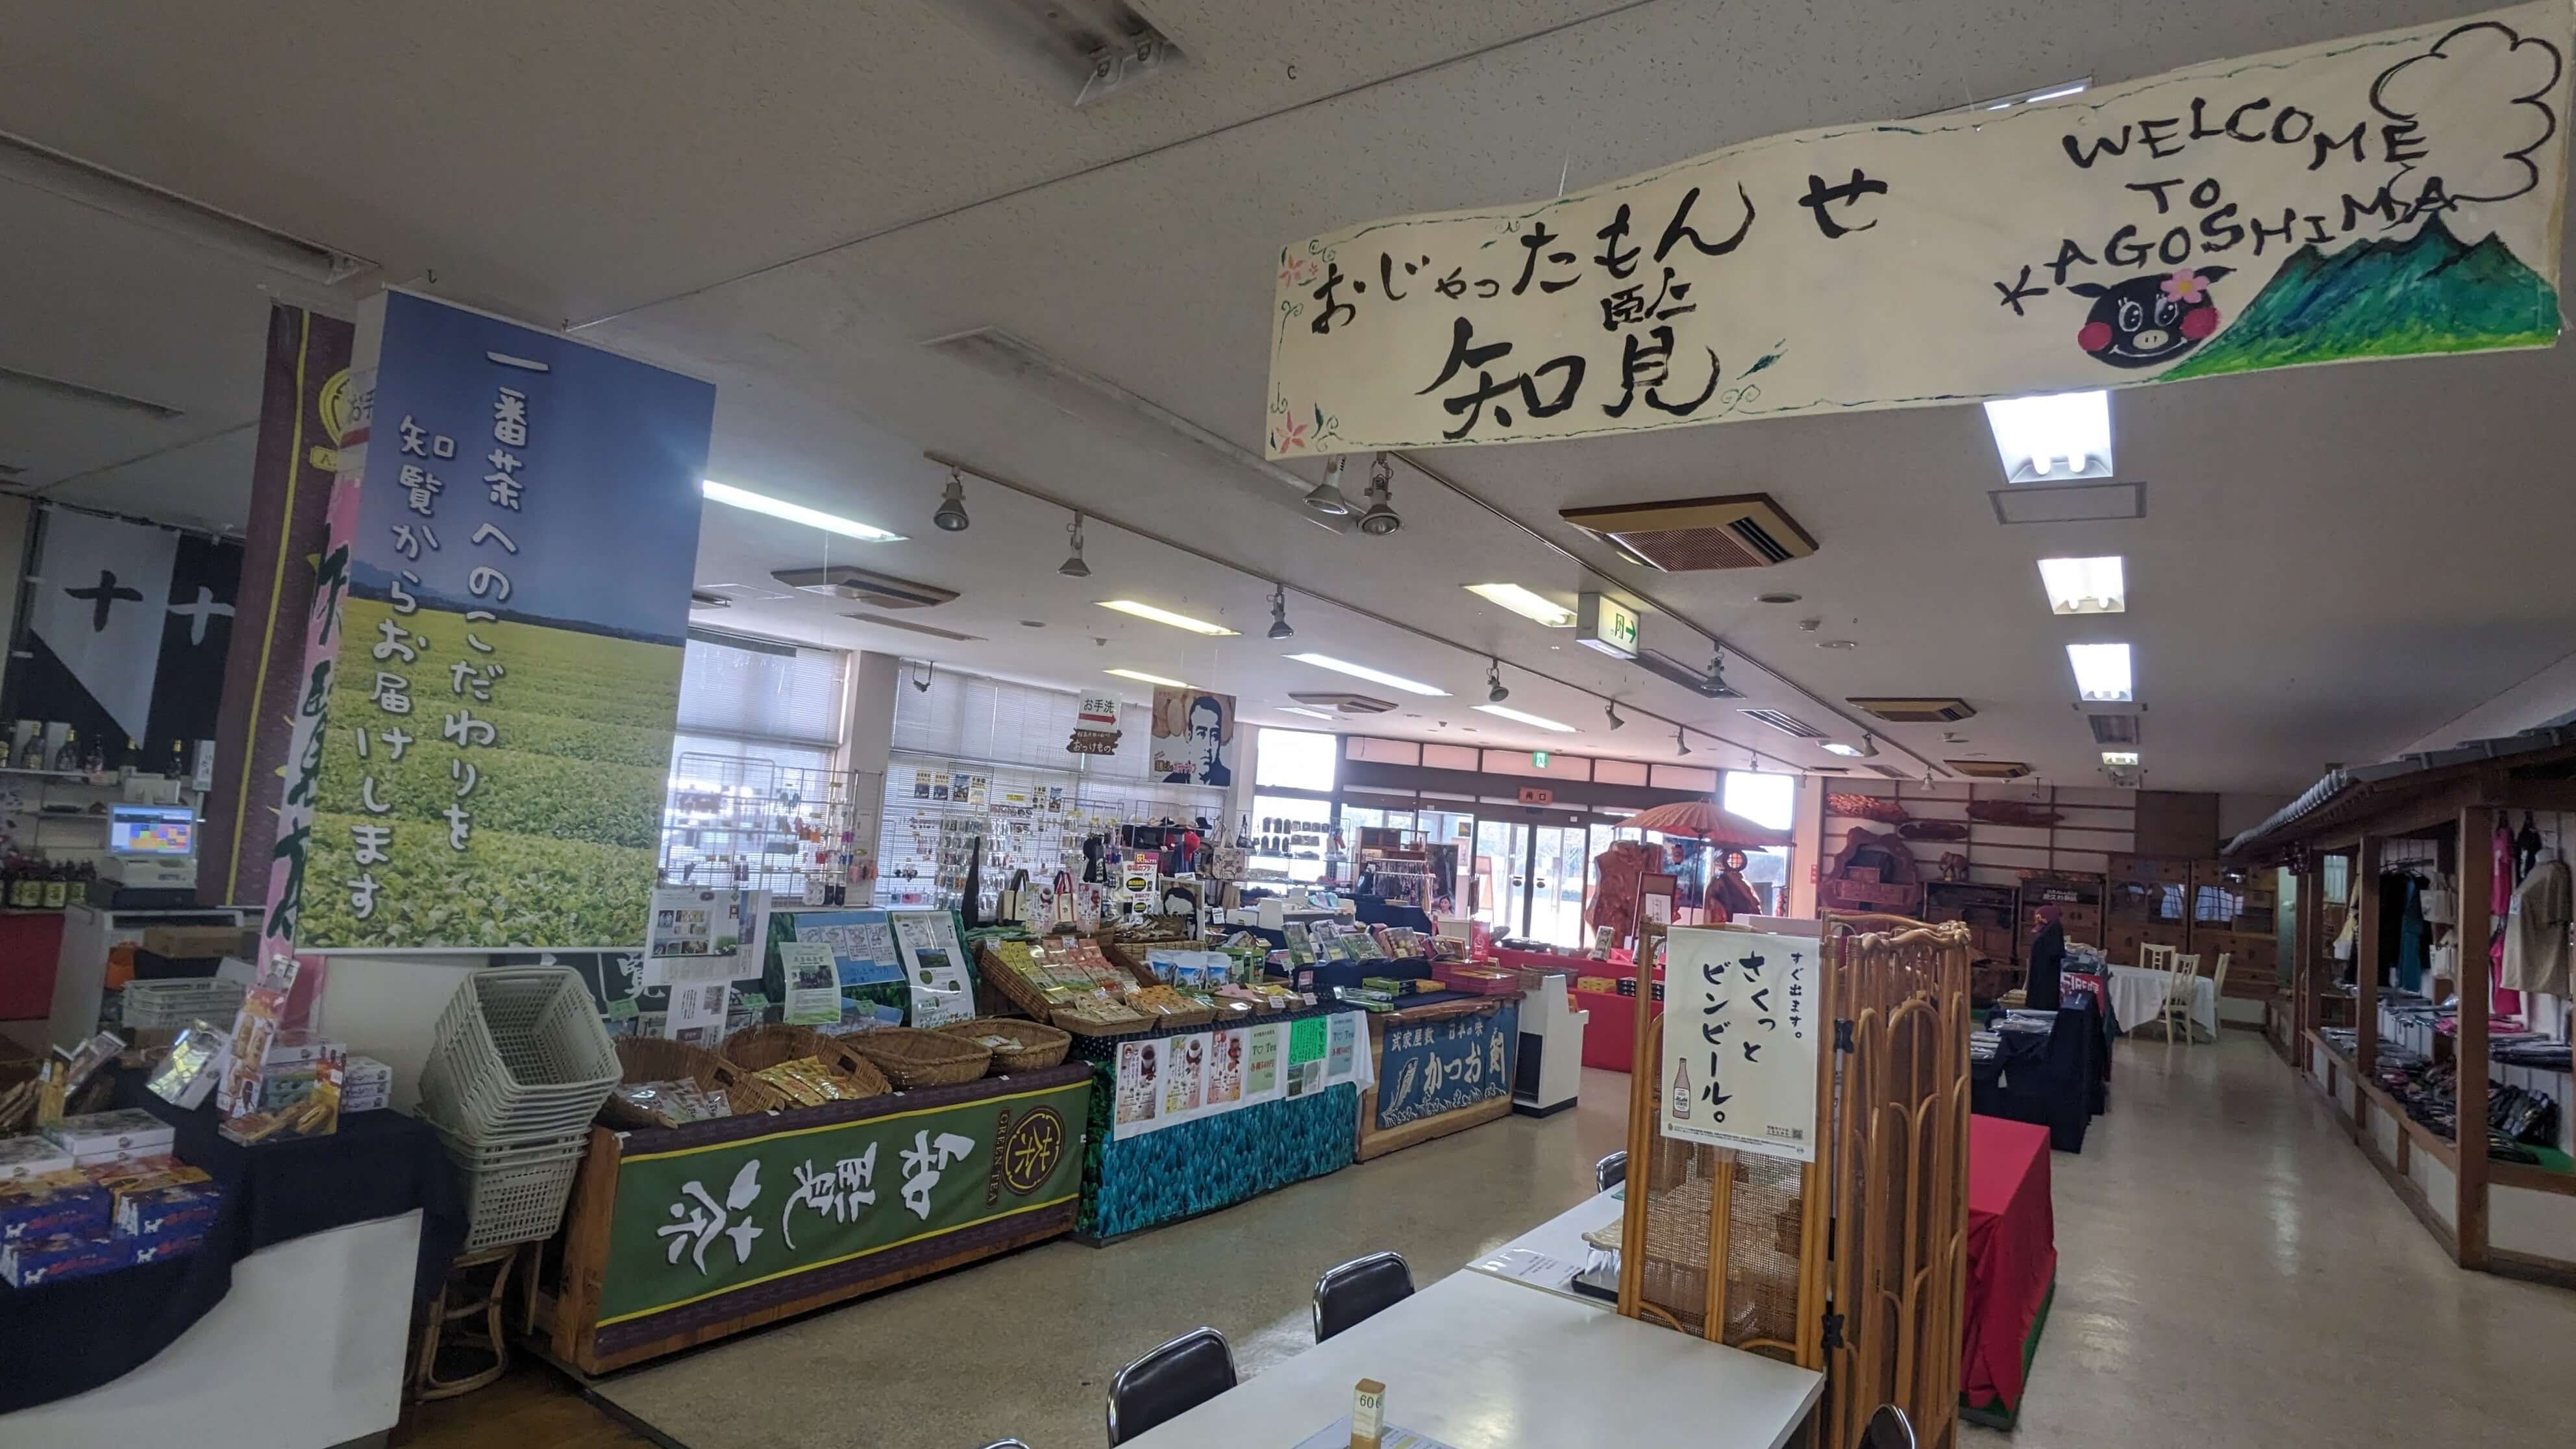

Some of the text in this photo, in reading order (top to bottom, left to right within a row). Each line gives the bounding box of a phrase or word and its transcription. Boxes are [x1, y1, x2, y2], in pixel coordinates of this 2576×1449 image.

[2063, 97, 2427, 169] WELCOME
[2125, 177, 2221, 214] TO
[1312, 167, 1888, 334] おじゃったもんせ
[1994, 176, 2457, 316] KAGOSHIMA
[1415, 267, 1720, 439] 知覧
[443, 349, 551, 852] 一番茶へのこだわりを
[349, 414, 456, 920] 知覧からお届けします
[1084, 698, 1115, 713] お手洗
[1702, 961, 1733, 1123] ビンビール。
[1739, 950, 1776, 1063] さくっと
[1789, 952, 1804, 1039] すぐ出ます。
[987, 1113, 1009, 1202] GREEN TEA
